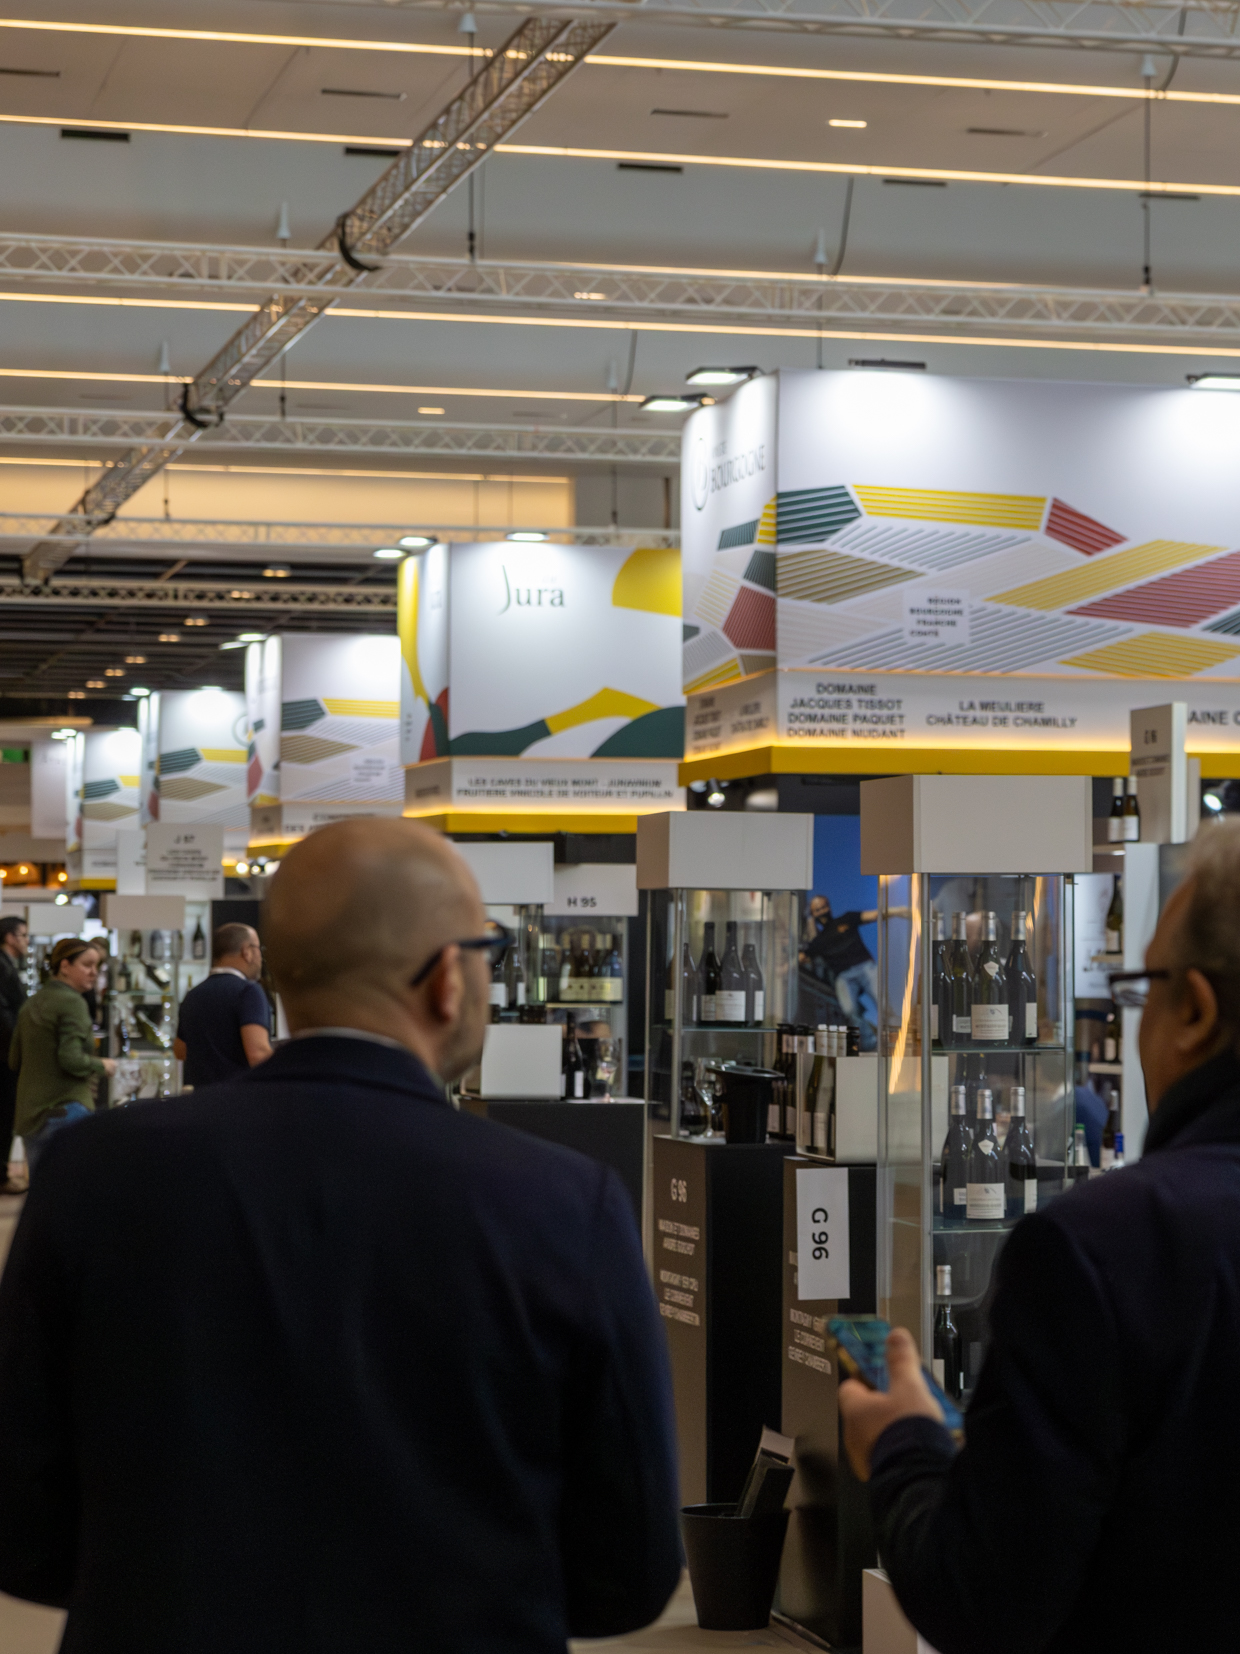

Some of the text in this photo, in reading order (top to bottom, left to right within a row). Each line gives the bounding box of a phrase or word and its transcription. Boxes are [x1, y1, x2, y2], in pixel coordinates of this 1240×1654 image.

[496, 565, 567, 617] Jura
[816, 682, 877, 695] DOMAINE
[789, 698, 903, 710] JACQUES TISSOT
[959, 700, 976, 712] LA
[788, 712, 905, 725] DOMAINE PAQUET
[992, 715, 1009, 727] DE
[1012, 716, 1077, 728] CHAMILLY
[787, 727, 905, 739] DOMAINE NUDANT
[567, 896, 578, 908] H
[812, 1208, 829, 1260] G 96
